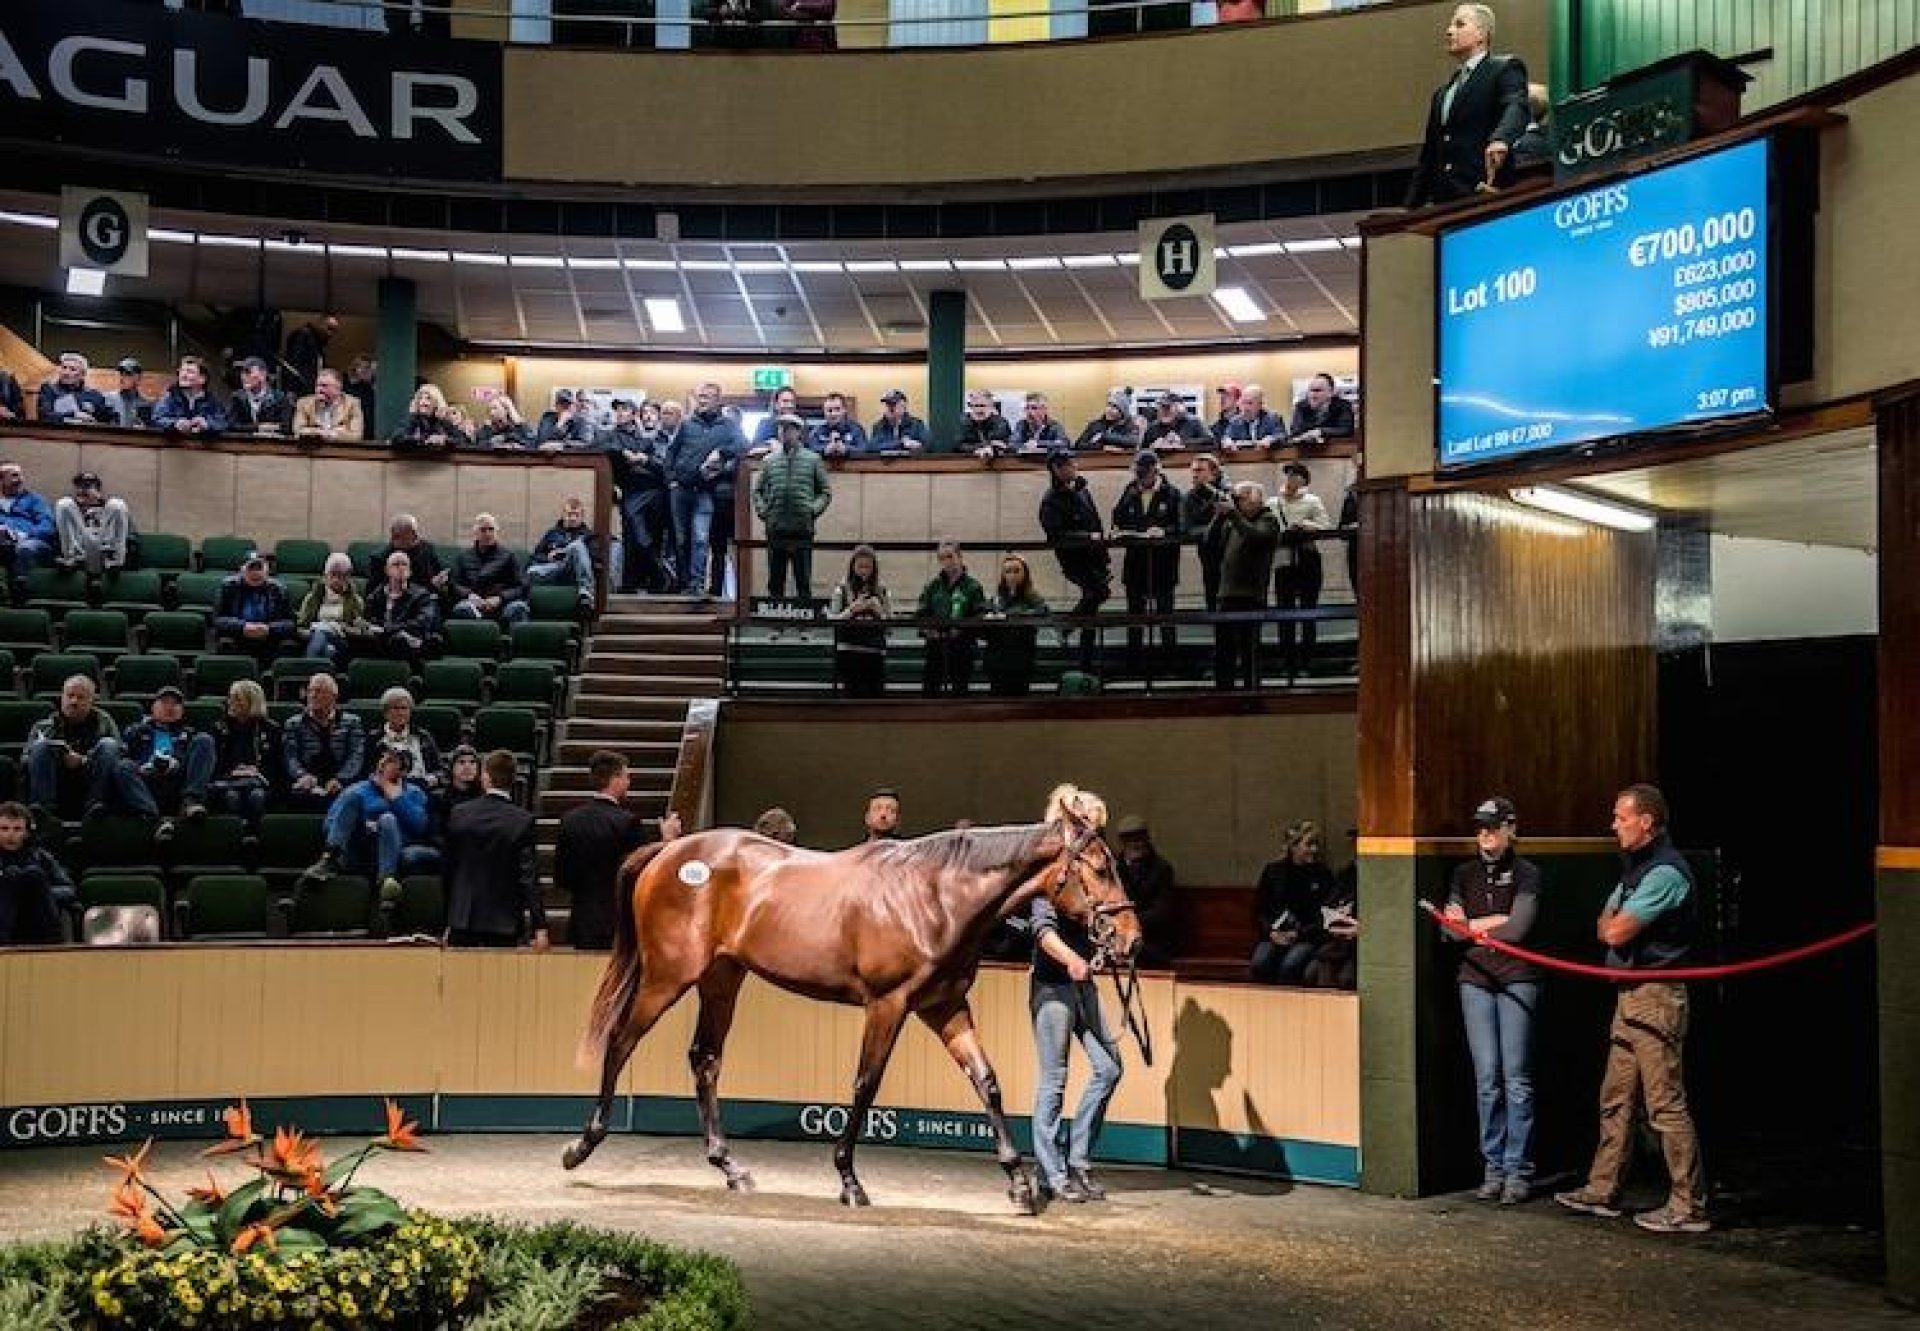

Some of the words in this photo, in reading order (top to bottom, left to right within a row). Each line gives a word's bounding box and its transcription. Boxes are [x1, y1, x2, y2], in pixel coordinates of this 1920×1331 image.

[1555, 184, 1629, 229] GOFFS
[86, 211, 122, 249] G
[1629, 207, 1756, 267] €700,000
[1161, 240, 1194, 275] H
[1674, 250, 1756, 288] £623,000
[1448, 281, 1488, 316] Lot
[1494, 266, 1537, 303] 100
[1731, 386, 1757, 408] pm
[9, 1103, 126, 1140] GOFFS
[150, 1108, 206, 1125] SINCE
[800, 1105, 898, 1141] GOFS
[918, 1119, 963, 1137] SINCE
